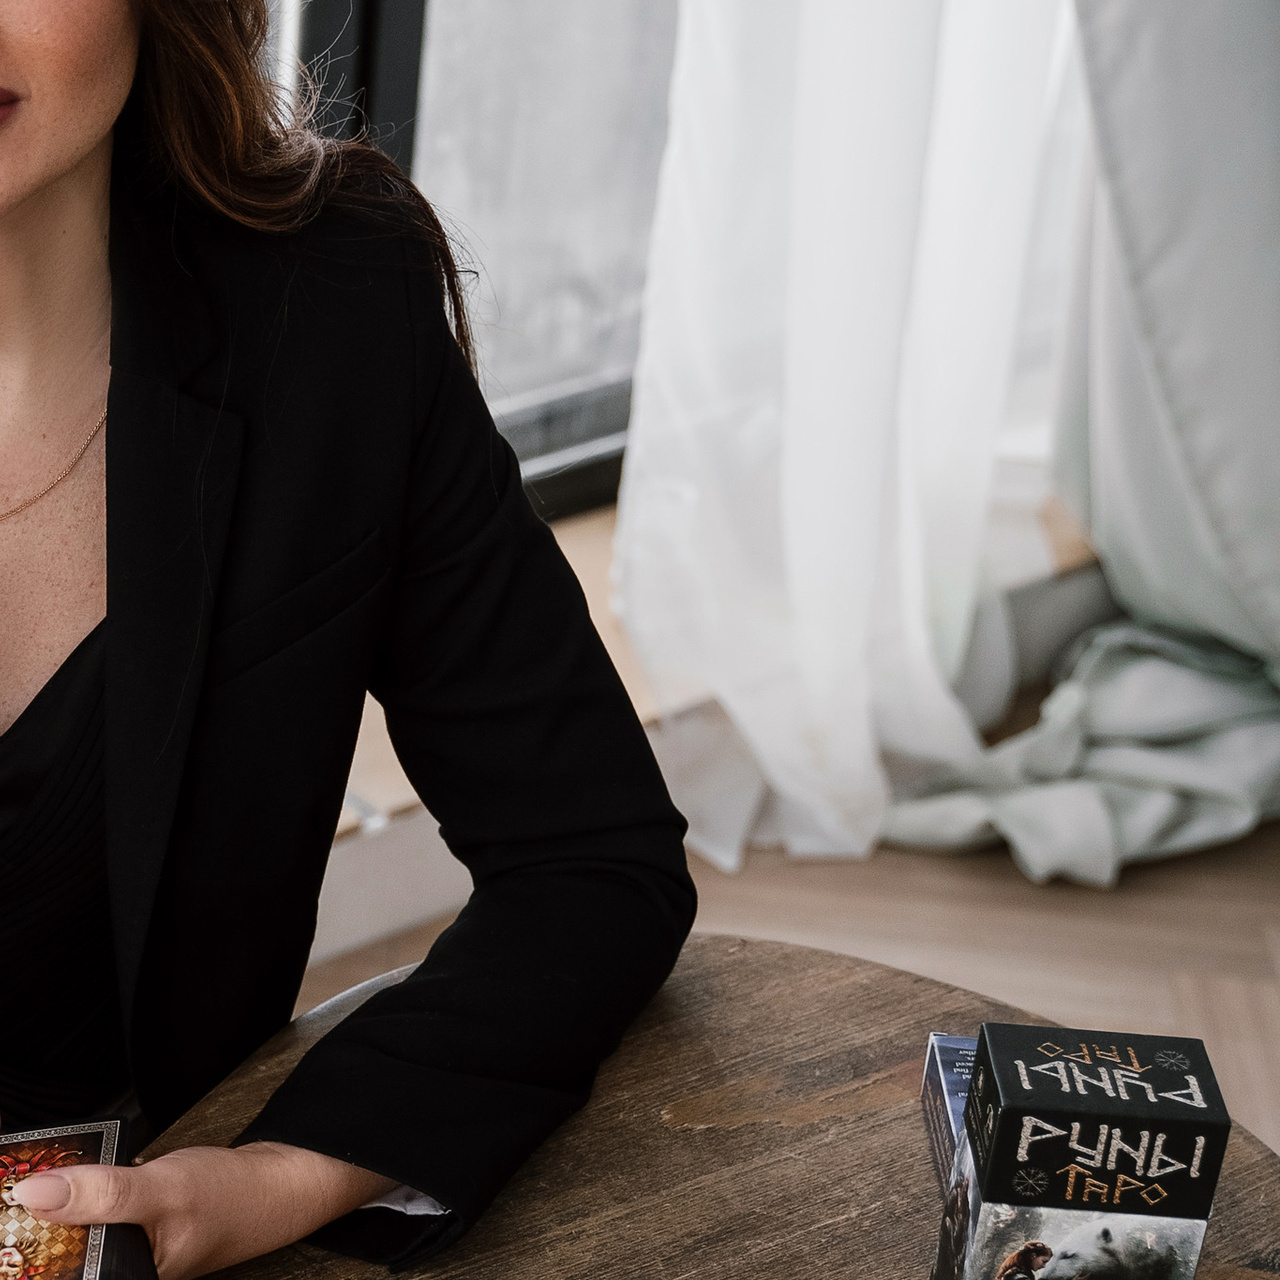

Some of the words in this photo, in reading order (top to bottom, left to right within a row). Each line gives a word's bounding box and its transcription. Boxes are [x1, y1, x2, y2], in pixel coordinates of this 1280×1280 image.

[1037, 1042, 1152, 1072] ТАРО
[1014, 1060, 1207, 1109] РУНЫ
[1017, 1116, 1205, 1178] РУНЫ
[1056, 1164, 1168, 1205] ТАРО
